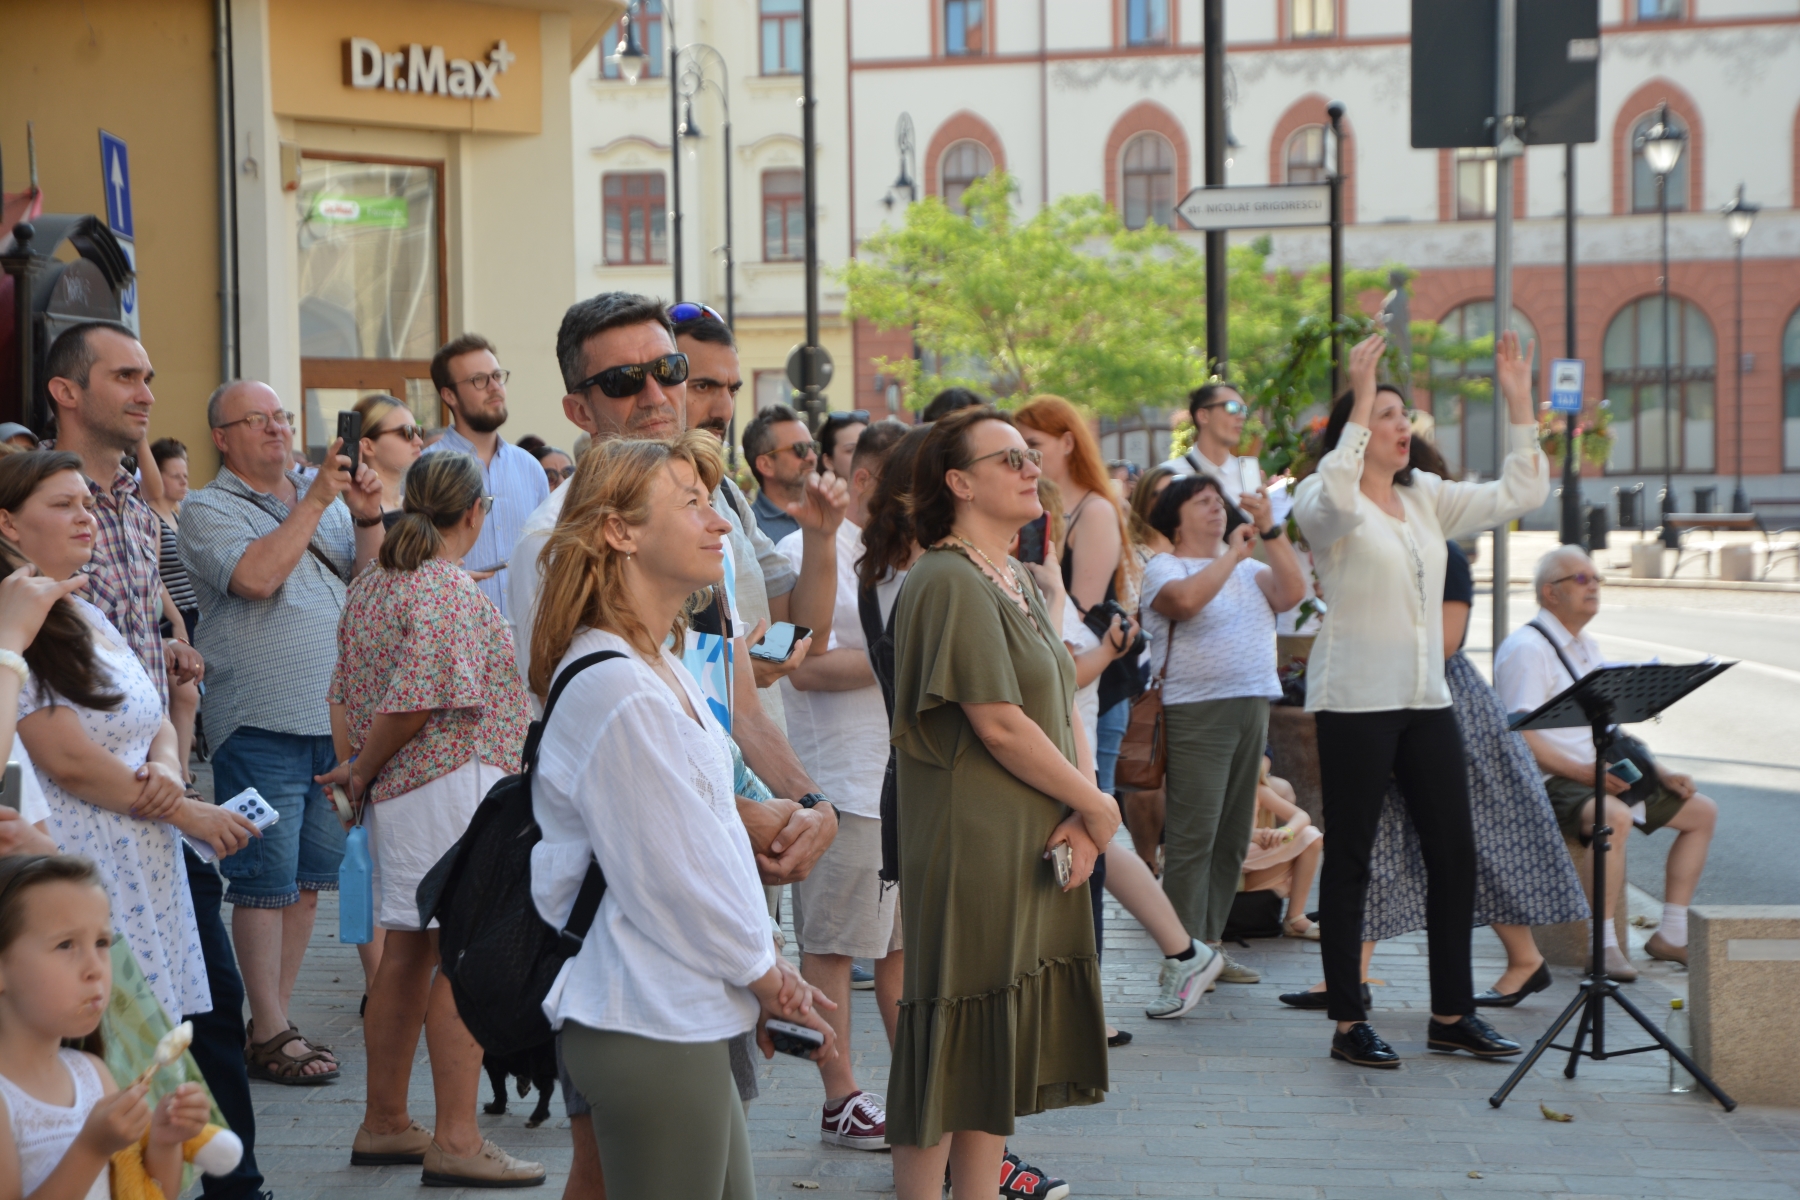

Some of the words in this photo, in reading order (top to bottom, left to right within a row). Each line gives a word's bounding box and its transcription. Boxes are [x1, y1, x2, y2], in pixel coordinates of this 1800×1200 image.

[1206, 202, 1251, 213] NICOLAE
[1254, 199, 1323, 211] GRIGORESCU
[1557, 393, 1578, 407] TAXI
[1000, 1160, 1040, 1195] IR
